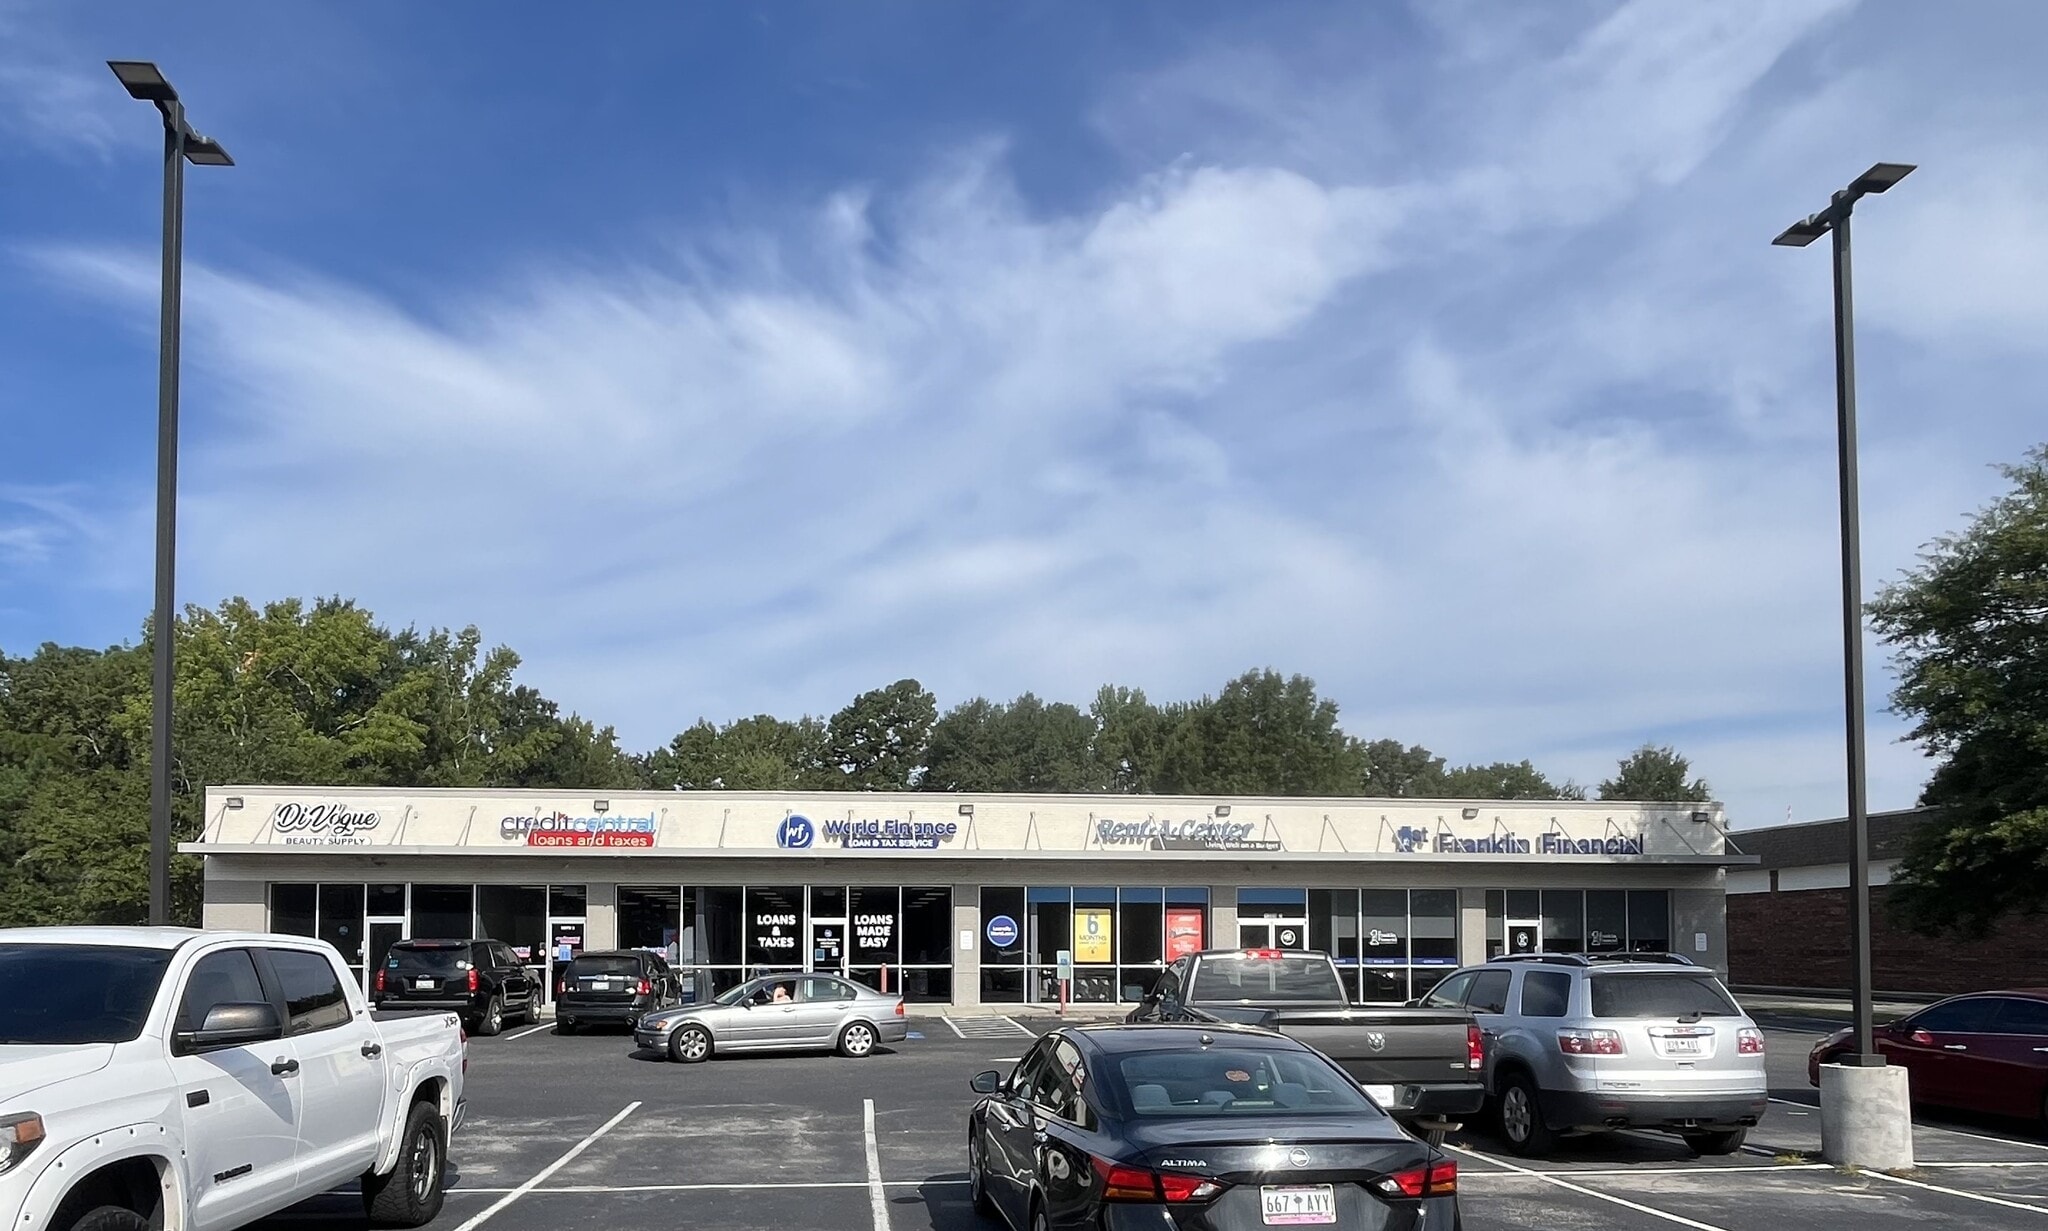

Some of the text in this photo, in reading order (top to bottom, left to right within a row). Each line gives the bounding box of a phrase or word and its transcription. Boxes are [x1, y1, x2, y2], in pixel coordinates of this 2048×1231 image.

[825, 819, 957, 835] World Finance
[328, 837, 365, 845] SUPPLY
[533, 833, 647, 846] loans and taxes
[848, 839, 871, 848] LOAN
[881, 839, 897, 848] TAX
[899, 839, 934, 848] SERVICE
[1437, 832, 1530, 854] Franklin
[1542, 832, 1643, 854] Financial
[757, 915, 796, 925] LOANS
[854, 915, 893, 925] LOANS
[1087, 913, 1098, 935] 6
[772, 926, 780, 936] &
[857, 926, 891, 936] MADE
[758, 937, 795, 948] TAXES
[860, 937, 888, 948] EASY
[1161, 1158, 1207, 1167] ALTIMA
[1267, 1194, 1329, 1213] 667 AYY
